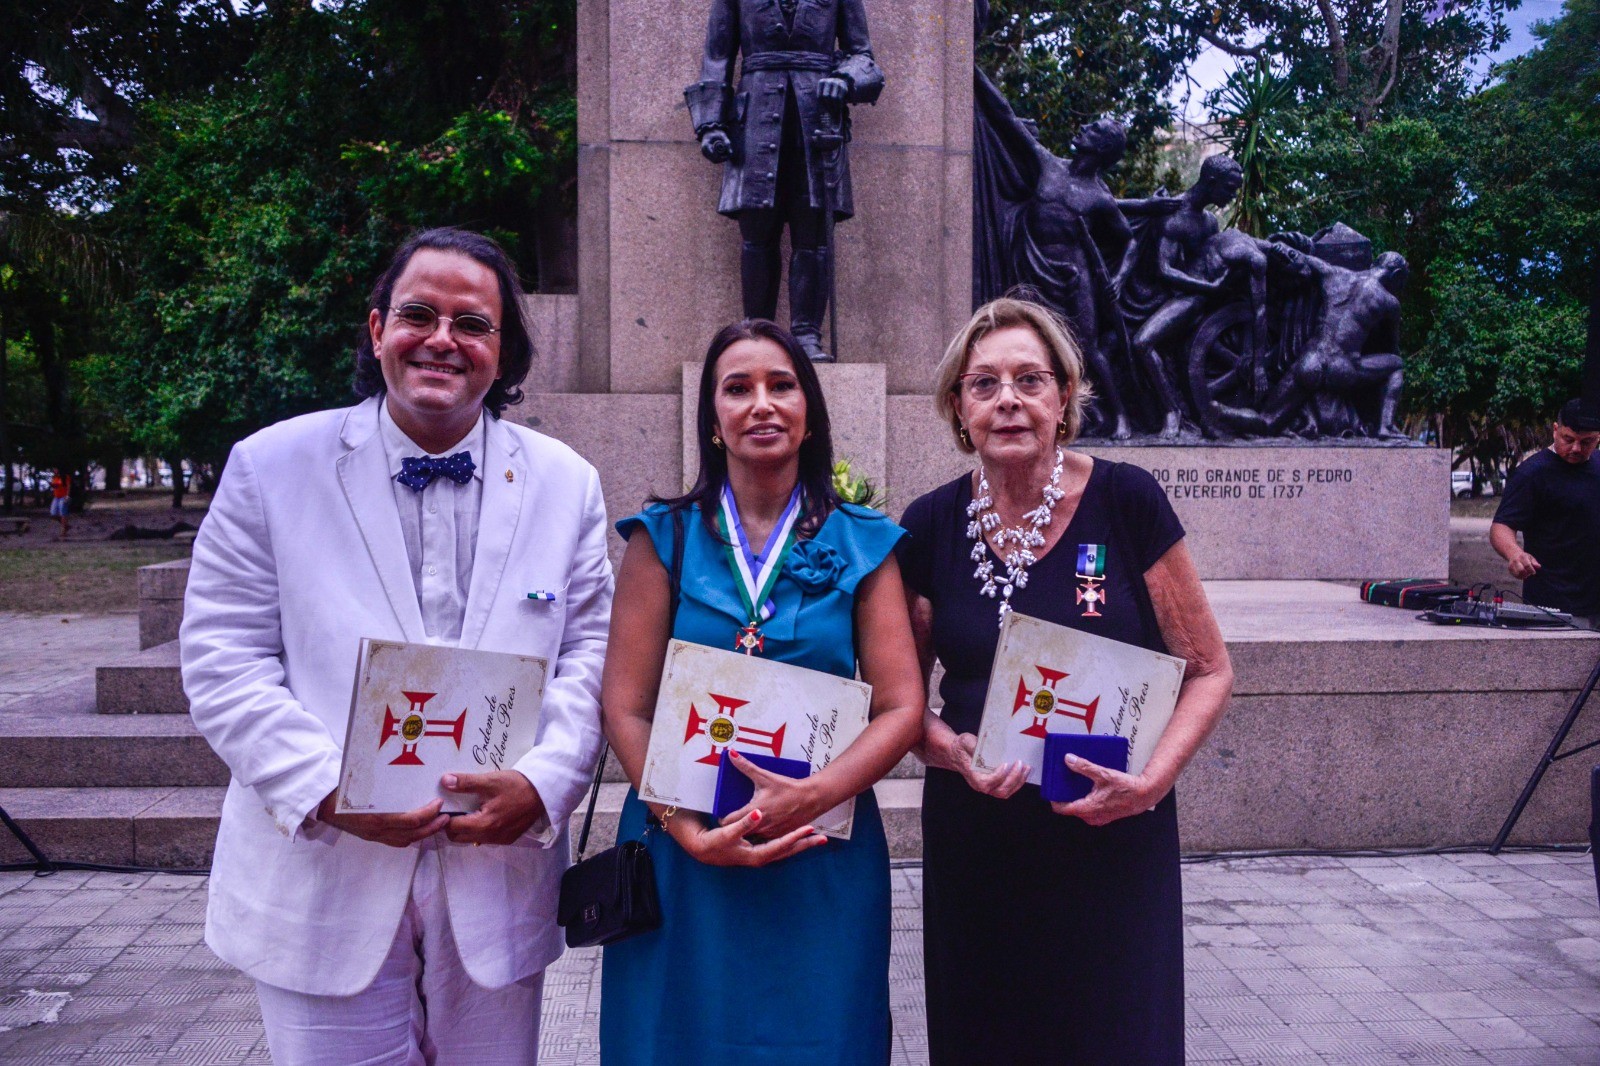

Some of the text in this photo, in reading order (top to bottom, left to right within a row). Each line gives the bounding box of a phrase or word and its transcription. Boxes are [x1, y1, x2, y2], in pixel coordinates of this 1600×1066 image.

[1152, 468, 1170, 483] DO
[1177, 468, 1199, 483] RIO
[1206, 468, 1260, 483] GRANDE
[1267, 468, 1285, 483] DE
[1307, 468, 1353, 483] PEDRO
[1165, 485, 1304, 499] FEVEREIRO DE 1737
[497, 685, 516, 727] Paes
[1117, 686, 1130, 705] de
[1129, 681, 1149, 721] Paes
[473, 694, 498, 765] Ordem de
[800, 713, 820, 763] dem de
[819, 707, 839, 749] Paes
